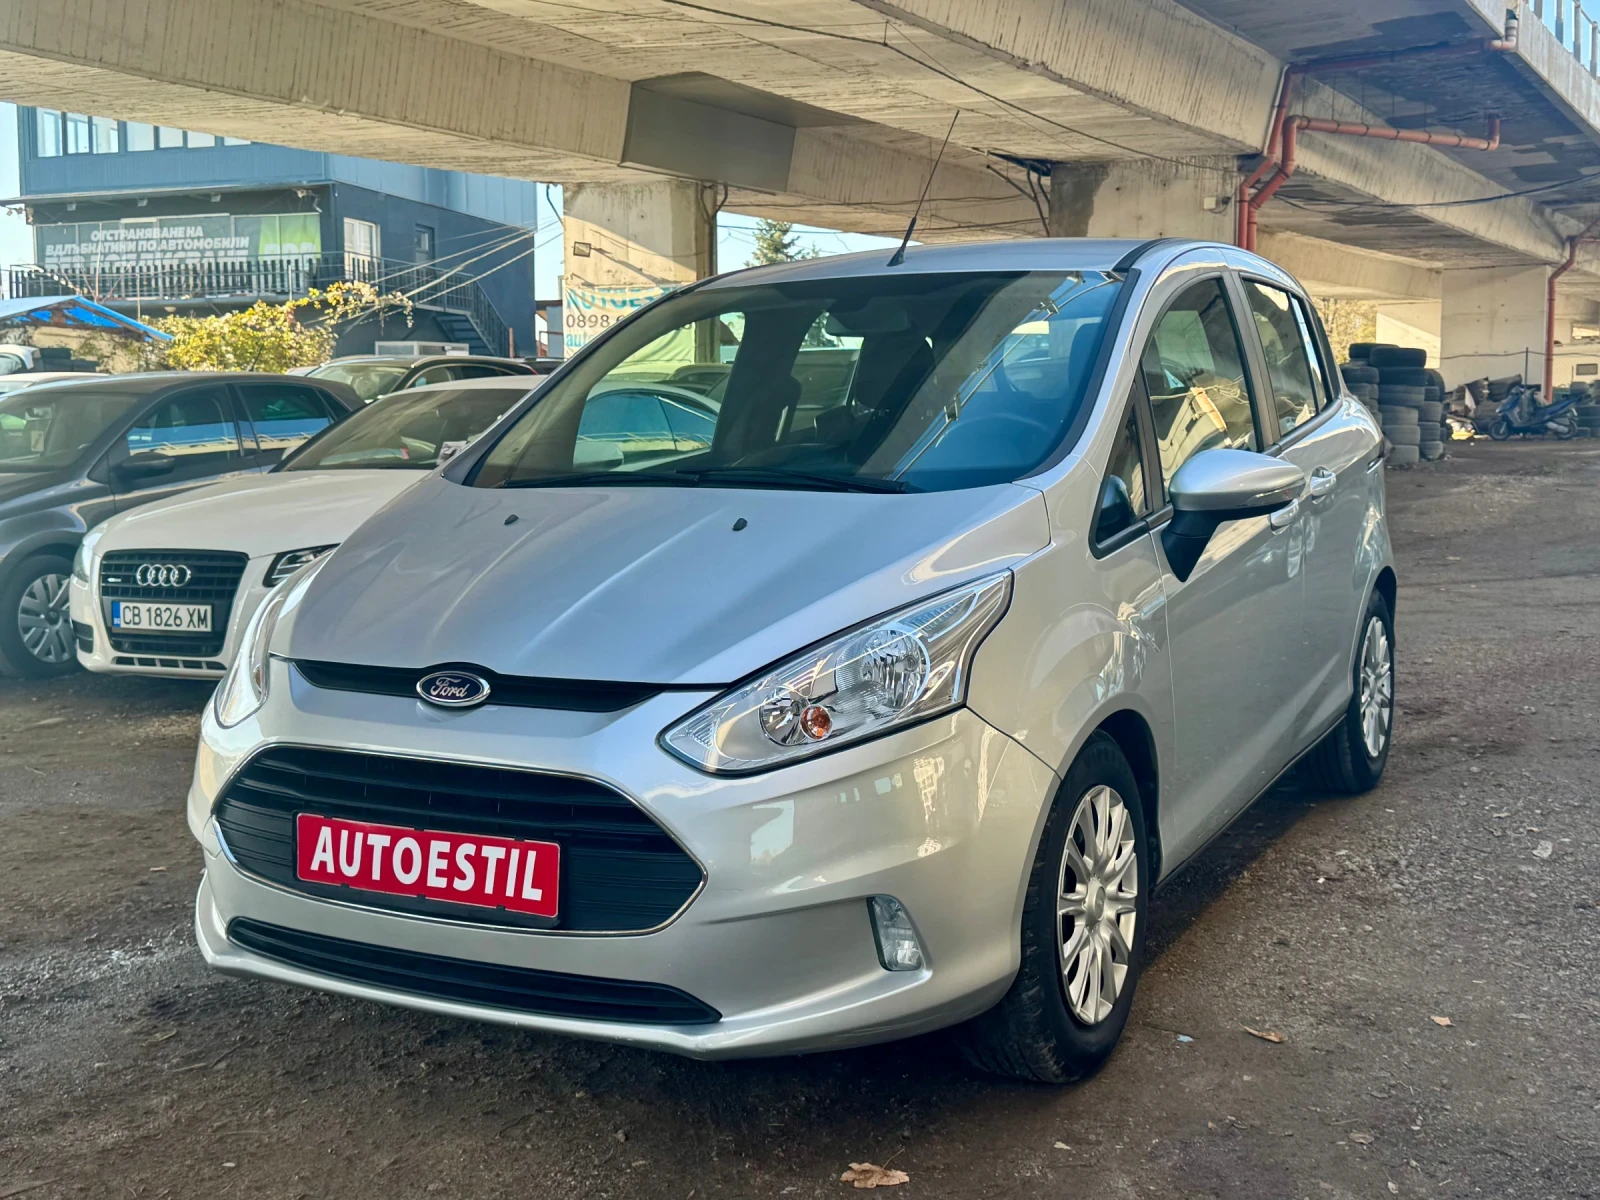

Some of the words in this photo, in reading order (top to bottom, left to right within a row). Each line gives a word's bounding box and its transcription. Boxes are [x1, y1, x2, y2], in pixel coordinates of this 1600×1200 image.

[186, 226, 204, 237] НА
[138, 240, 157, 252] ПО
[158, 236, 249, 251] АВТОМОБИЛИ
[565, 314, 611, 328] 0898
[122, 605, 142, 626] CB
[146, 606, 183, 627] 1826
[186, 608, 208, 629] XM
[430, 677, 470, 698] Ford
[310, 825, 543, 901] AUTOESTIL
